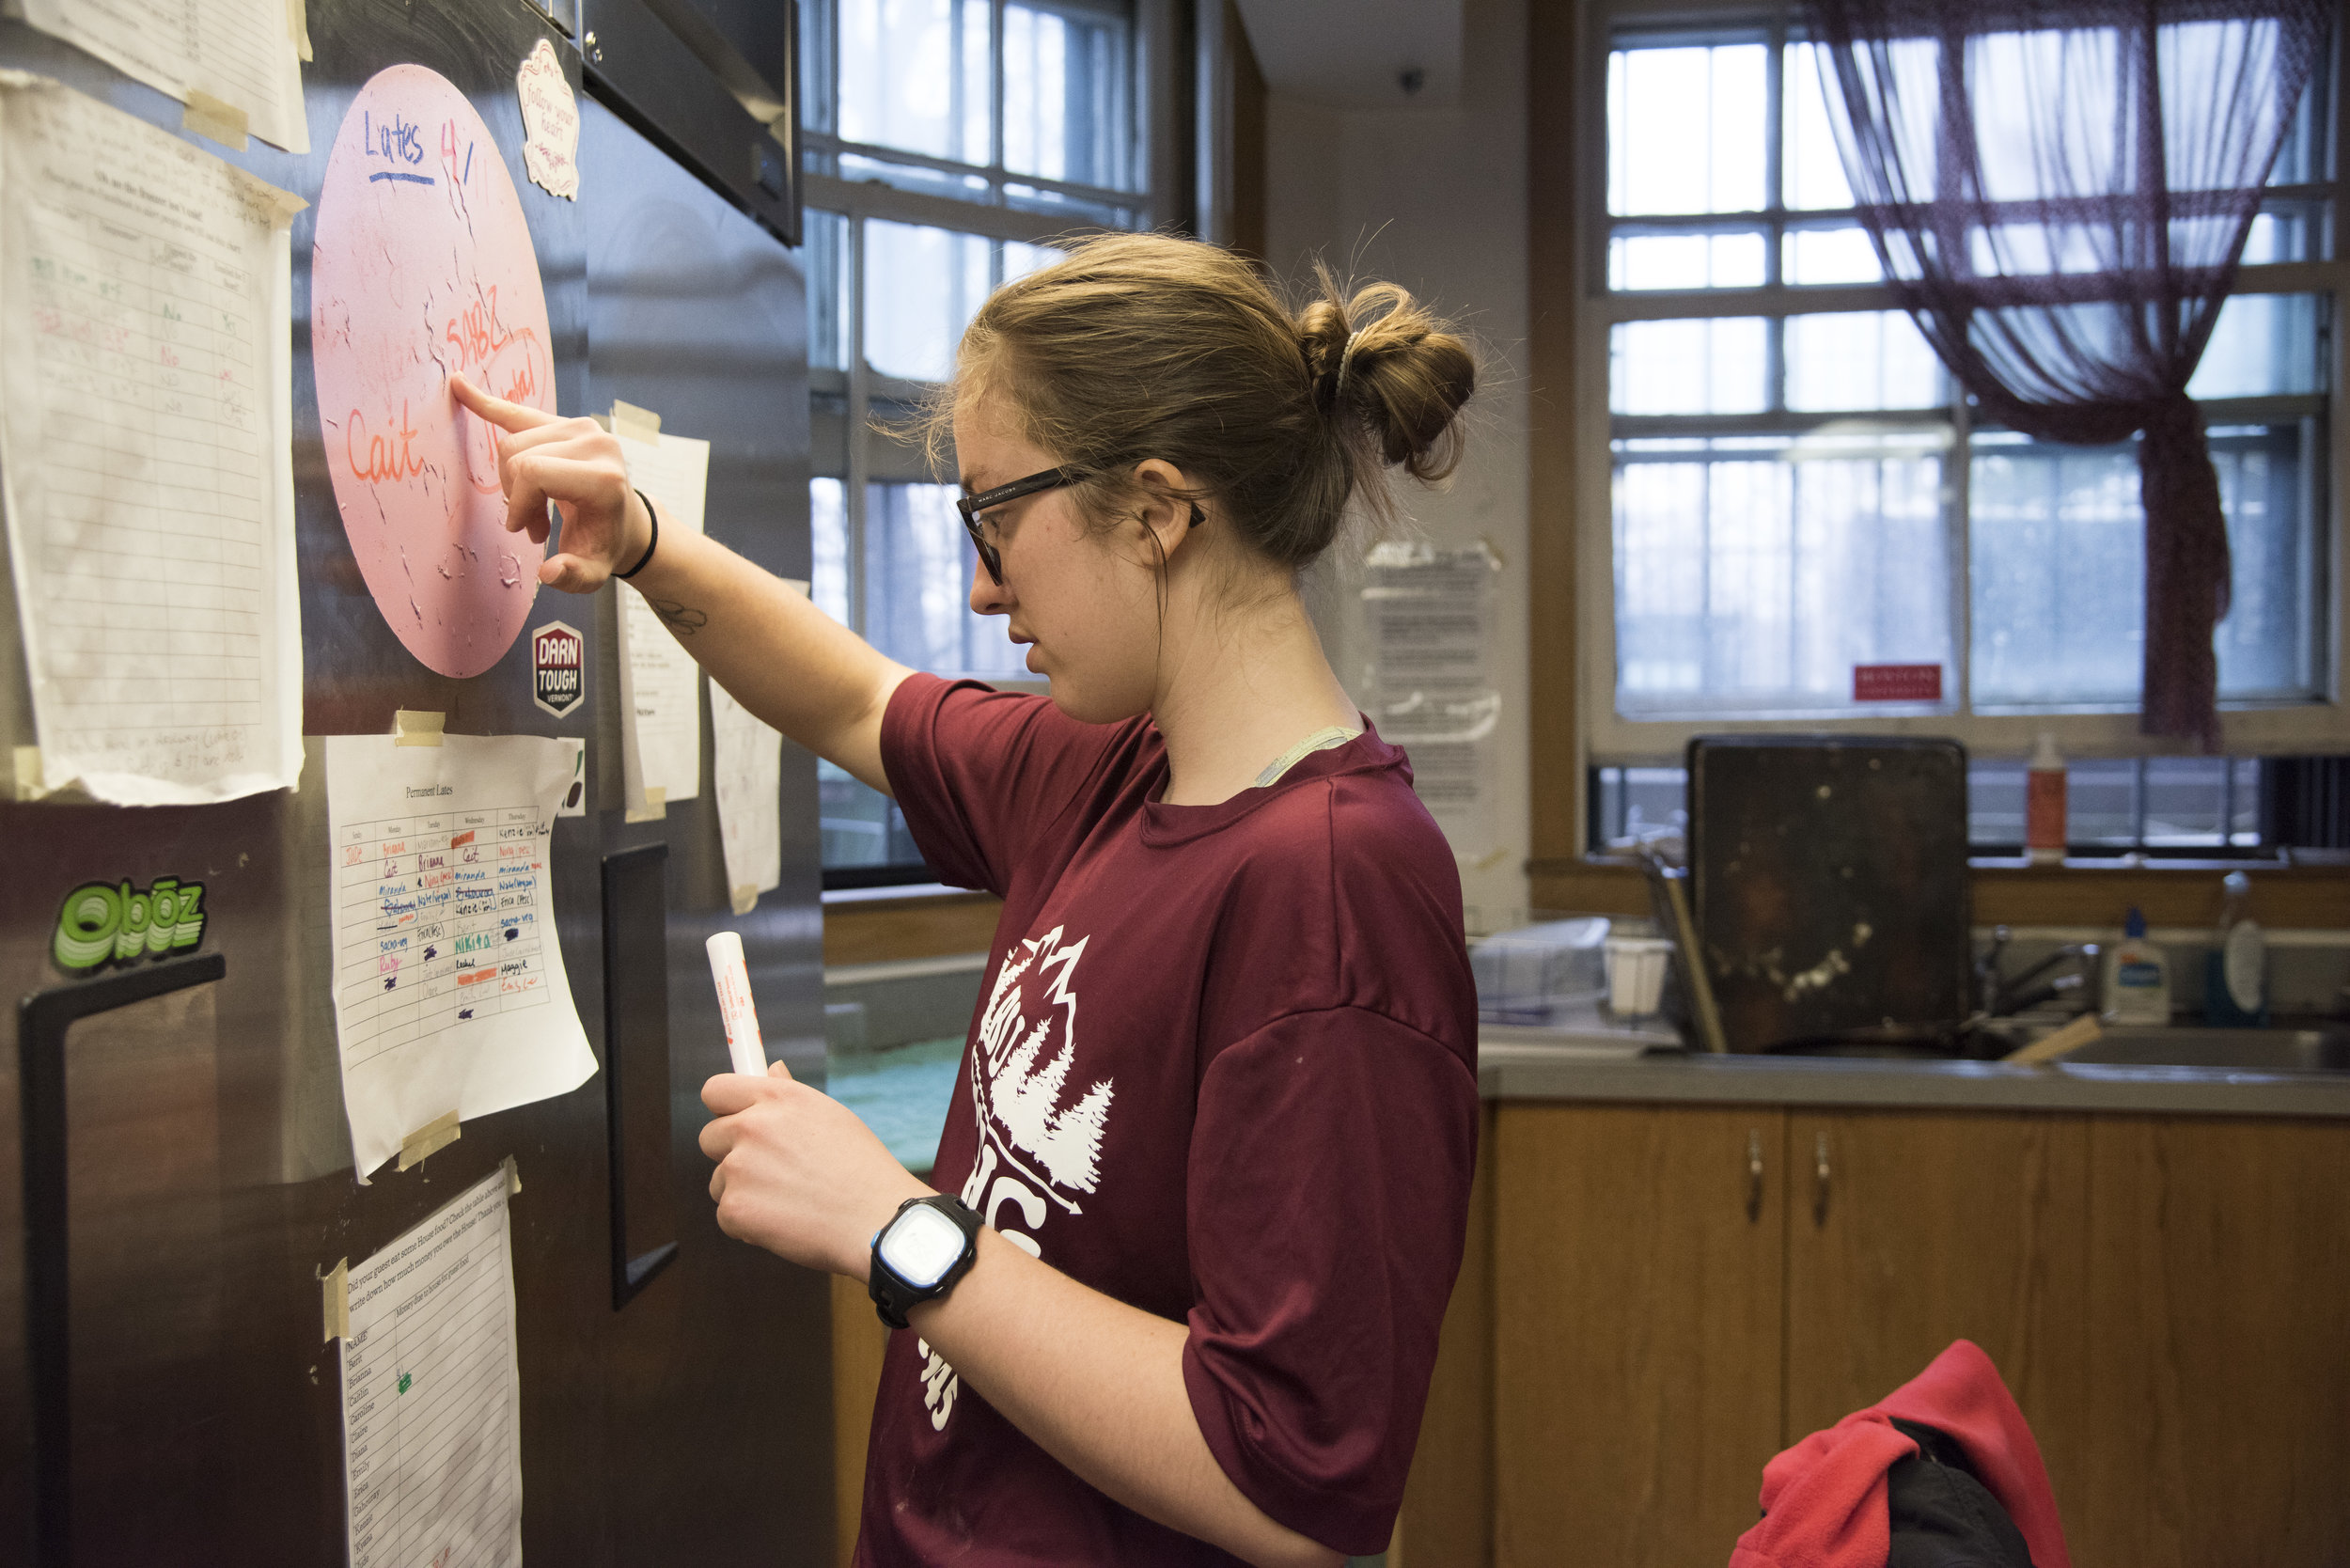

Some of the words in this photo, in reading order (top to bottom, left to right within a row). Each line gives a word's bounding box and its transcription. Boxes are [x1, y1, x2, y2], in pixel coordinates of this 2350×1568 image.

[365, 110, 424, 165] Lates
[348, 399, 424, 485] Cait
[978, 494, 993, 503] MARC
[995, 487, 1016, 497] JACOBS
[539, 637, 578, 666] DARN
[539, 669, 578, 692] TOUGH
[547, 693, 573, 703] VERMONT
[406, 786, 434, 798] Permanent
[435, 784, 453, 796] Lates
[380, 954, 402, 979] Ruby
[501, 959, 528, 976] Maggie
[347, 1278, 359, 1294] Did
[359, 1270, 374, 1290] your
[373, 1259, 391, 1279] guest
[391, 1252, 400, 1265] eat
[400, 1242, 417, 1259] some
[417, 1230, 434, 1247] House
[449, 1206, 465, 1225] Check
[349, 1296, 366, 1313] write
[366, 1283, 384, 1302] down
[383, 1275, 397, 1291] how
[397, 1262, 415, 1281] much
[415, 1249, 433, 1269] money
[432, 1242, 443, 1258] you
[452, 1229, 461, 1240] the
[478, 1204, 493, 1221] Thank
[493, 1200, 502, 1213] you
[395, 1301, 414, 1318] Money
[414, 1293, 425, 1306] due
[429, 1278, 442, 1294] house
[459, 1253, 470, 1269] food
[347, 1330, 368, 1353] NAME
[349, 1368, 372, 1390] Brianna
[350, 1402, 375, 1426] Caroline
